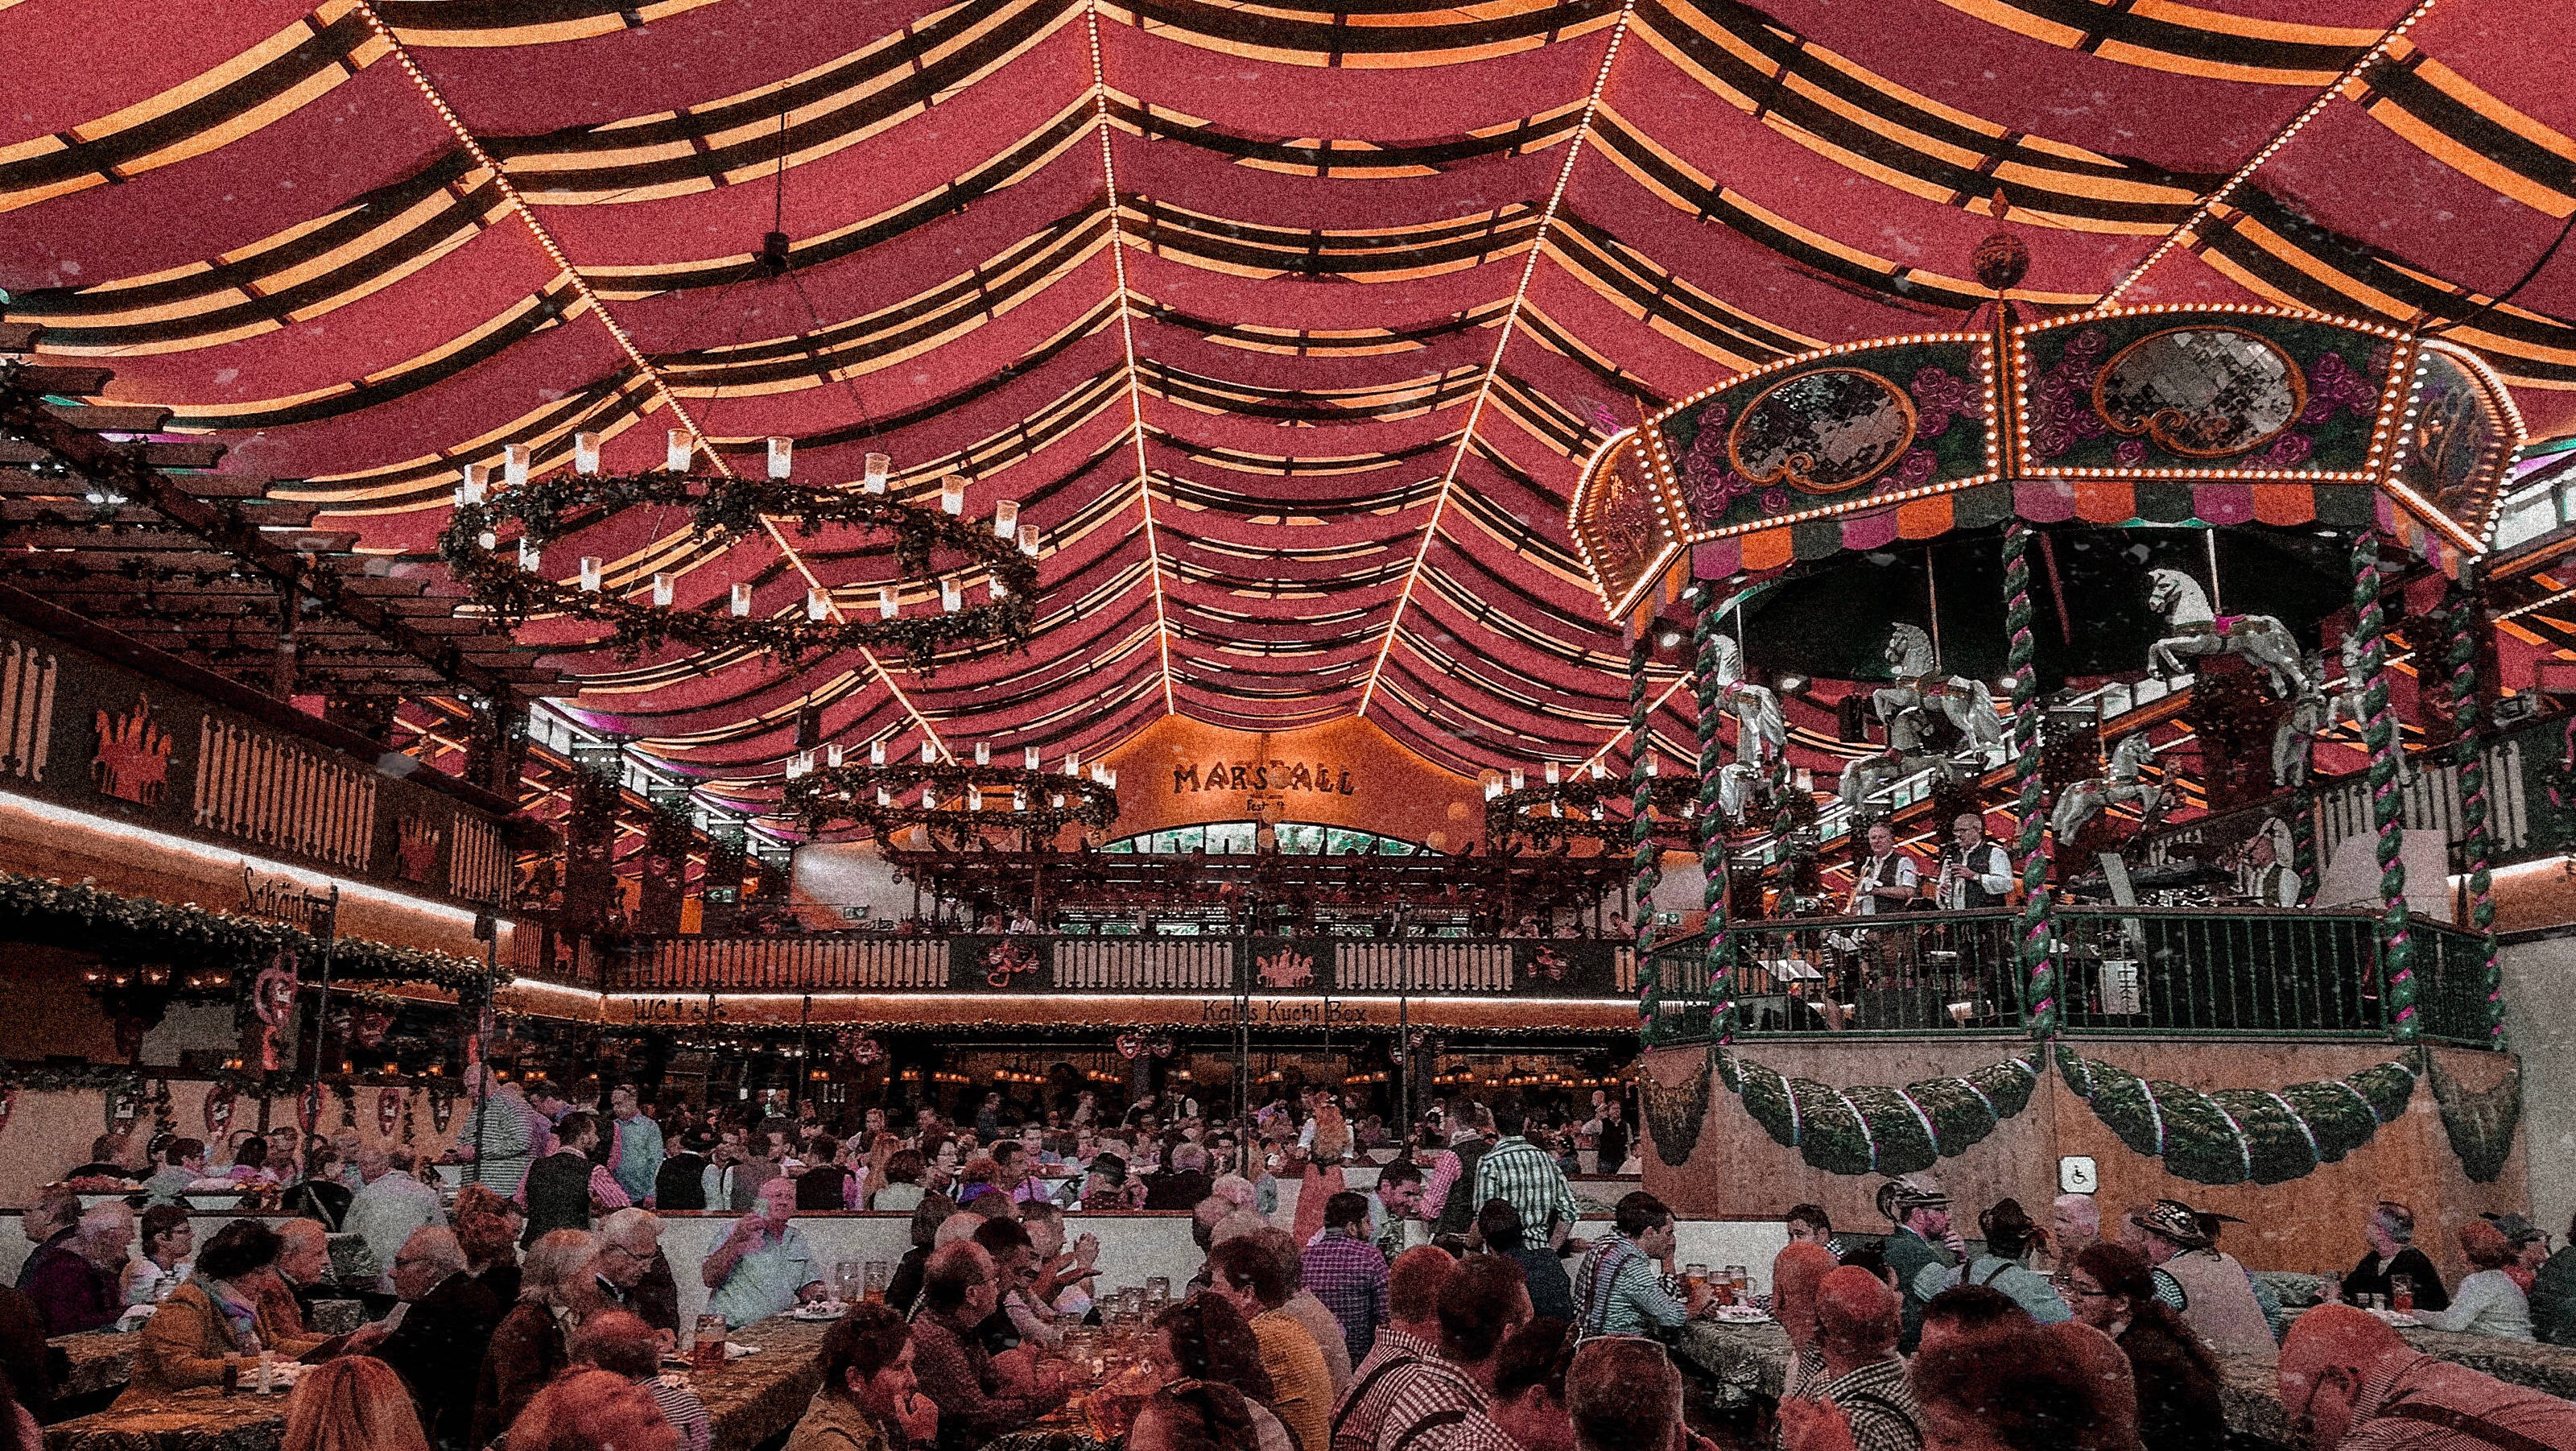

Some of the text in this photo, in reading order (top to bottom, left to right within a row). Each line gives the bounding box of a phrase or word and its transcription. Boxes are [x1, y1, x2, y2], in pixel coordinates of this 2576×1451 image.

[1174, 760, 1356, 796] MARSALL
[632, 998, 668, 1020] WC
[1202, 999, 1259, 1022] Kas
[1327, 1000, 1367, 1022] Box
